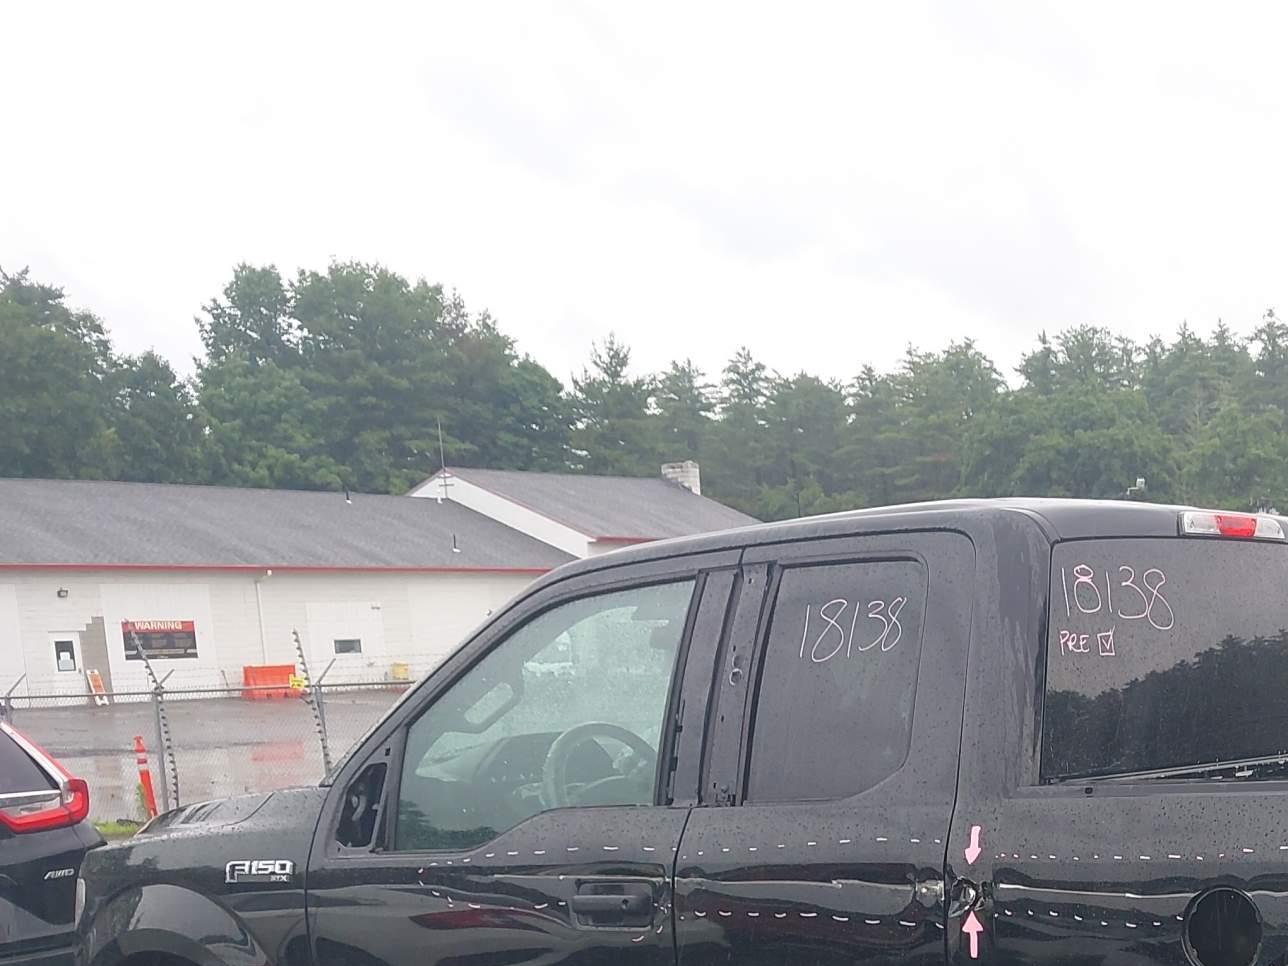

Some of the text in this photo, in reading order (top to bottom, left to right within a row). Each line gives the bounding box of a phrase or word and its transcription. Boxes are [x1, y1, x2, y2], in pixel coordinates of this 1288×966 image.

[1061, 564, 1175, 630] 18138
[134, 621, 182, 630] WARNING
[799, 596, 907, 663] 18138
[1059, 630, 1090, 656] PRE
[43, 868, 75, 880] AWD
